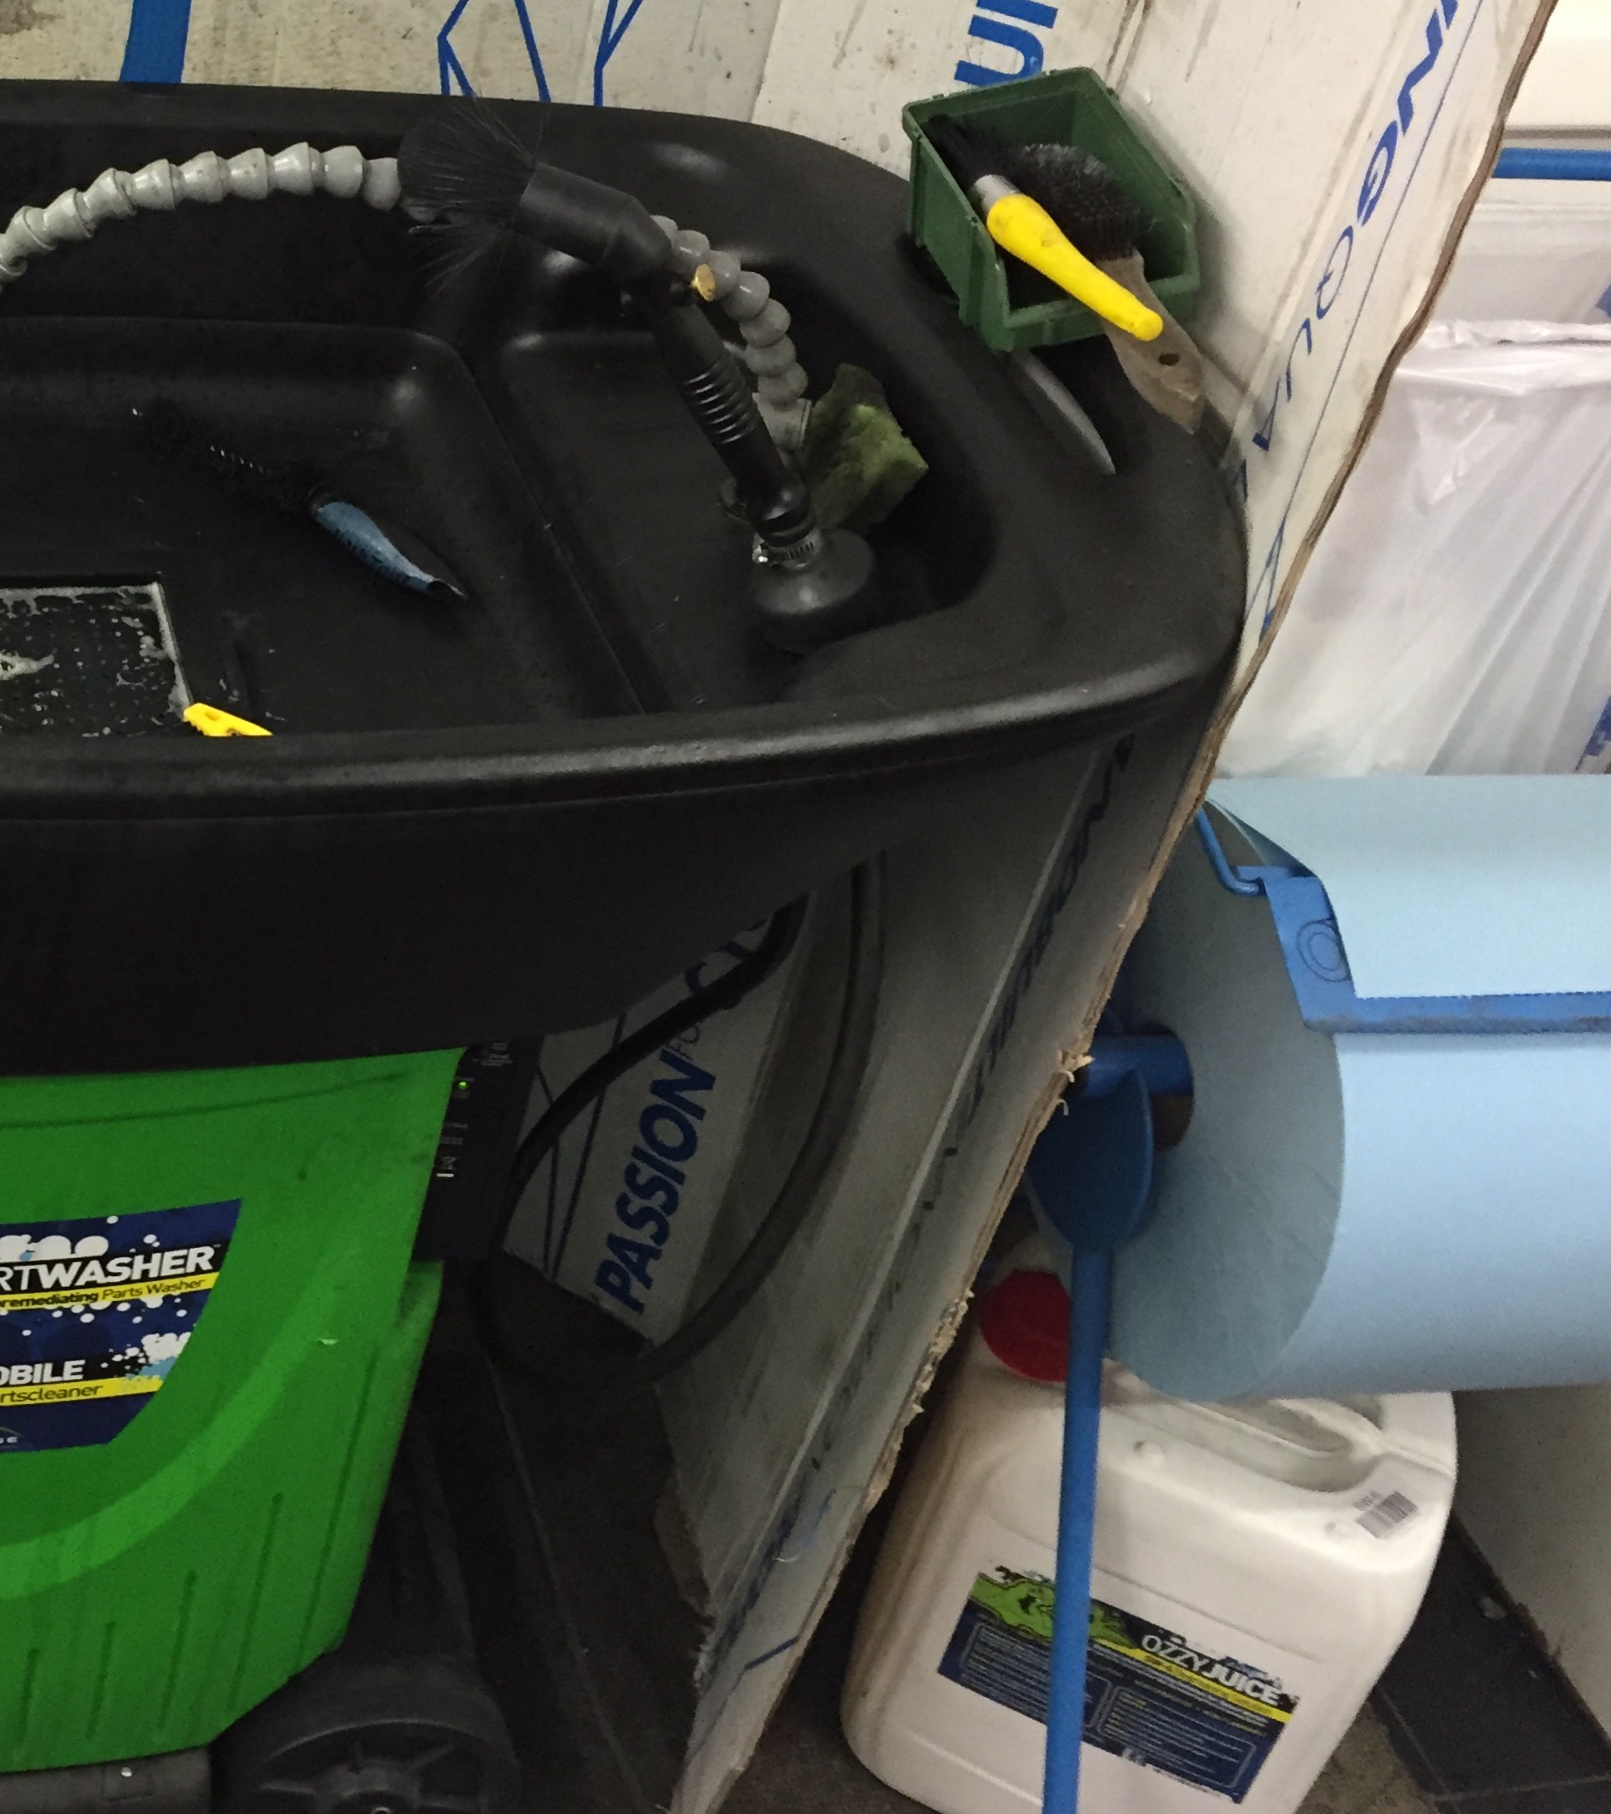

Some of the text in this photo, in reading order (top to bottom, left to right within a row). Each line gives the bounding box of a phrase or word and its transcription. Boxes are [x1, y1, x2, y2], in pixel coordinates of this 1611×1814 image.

[596, 1049, 717, 1315] PASSION
[101, 1287, 143, 1301] Parts
[146, 1278, 207, 1295] Washer
